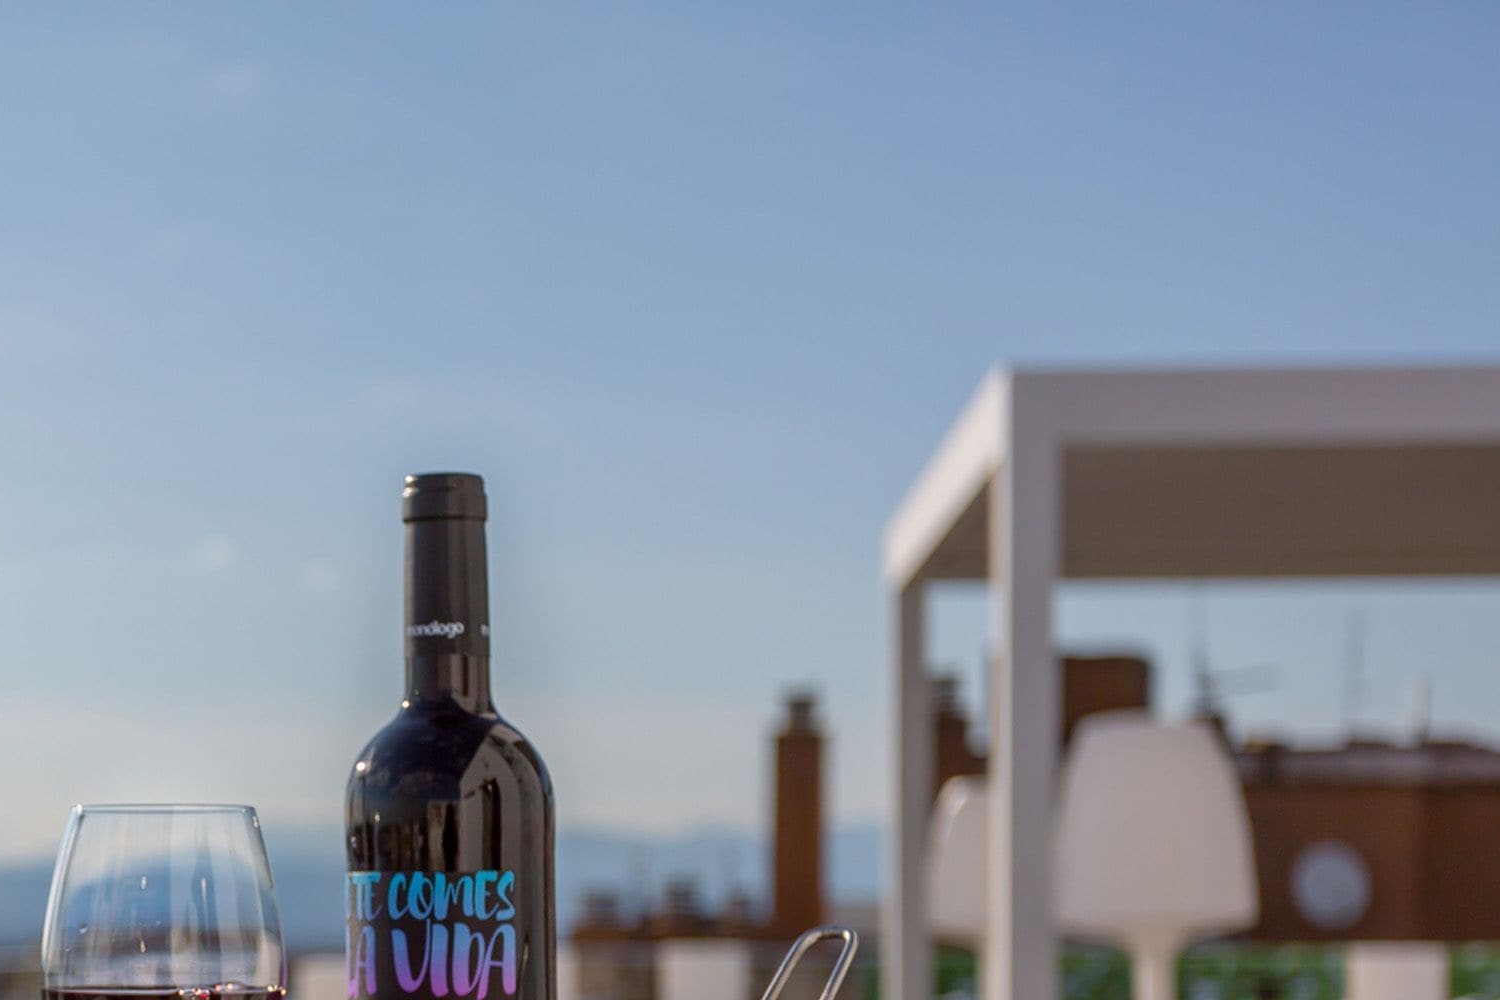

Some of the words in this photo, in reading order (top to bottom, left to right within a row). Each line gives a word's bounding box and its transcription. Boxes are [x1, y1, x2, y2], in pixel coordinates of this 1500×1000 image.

[348, 870, 383, 921] TE
[388, 870, 516, 921] COMES
[391, 918, 517, 1000] VIDA
